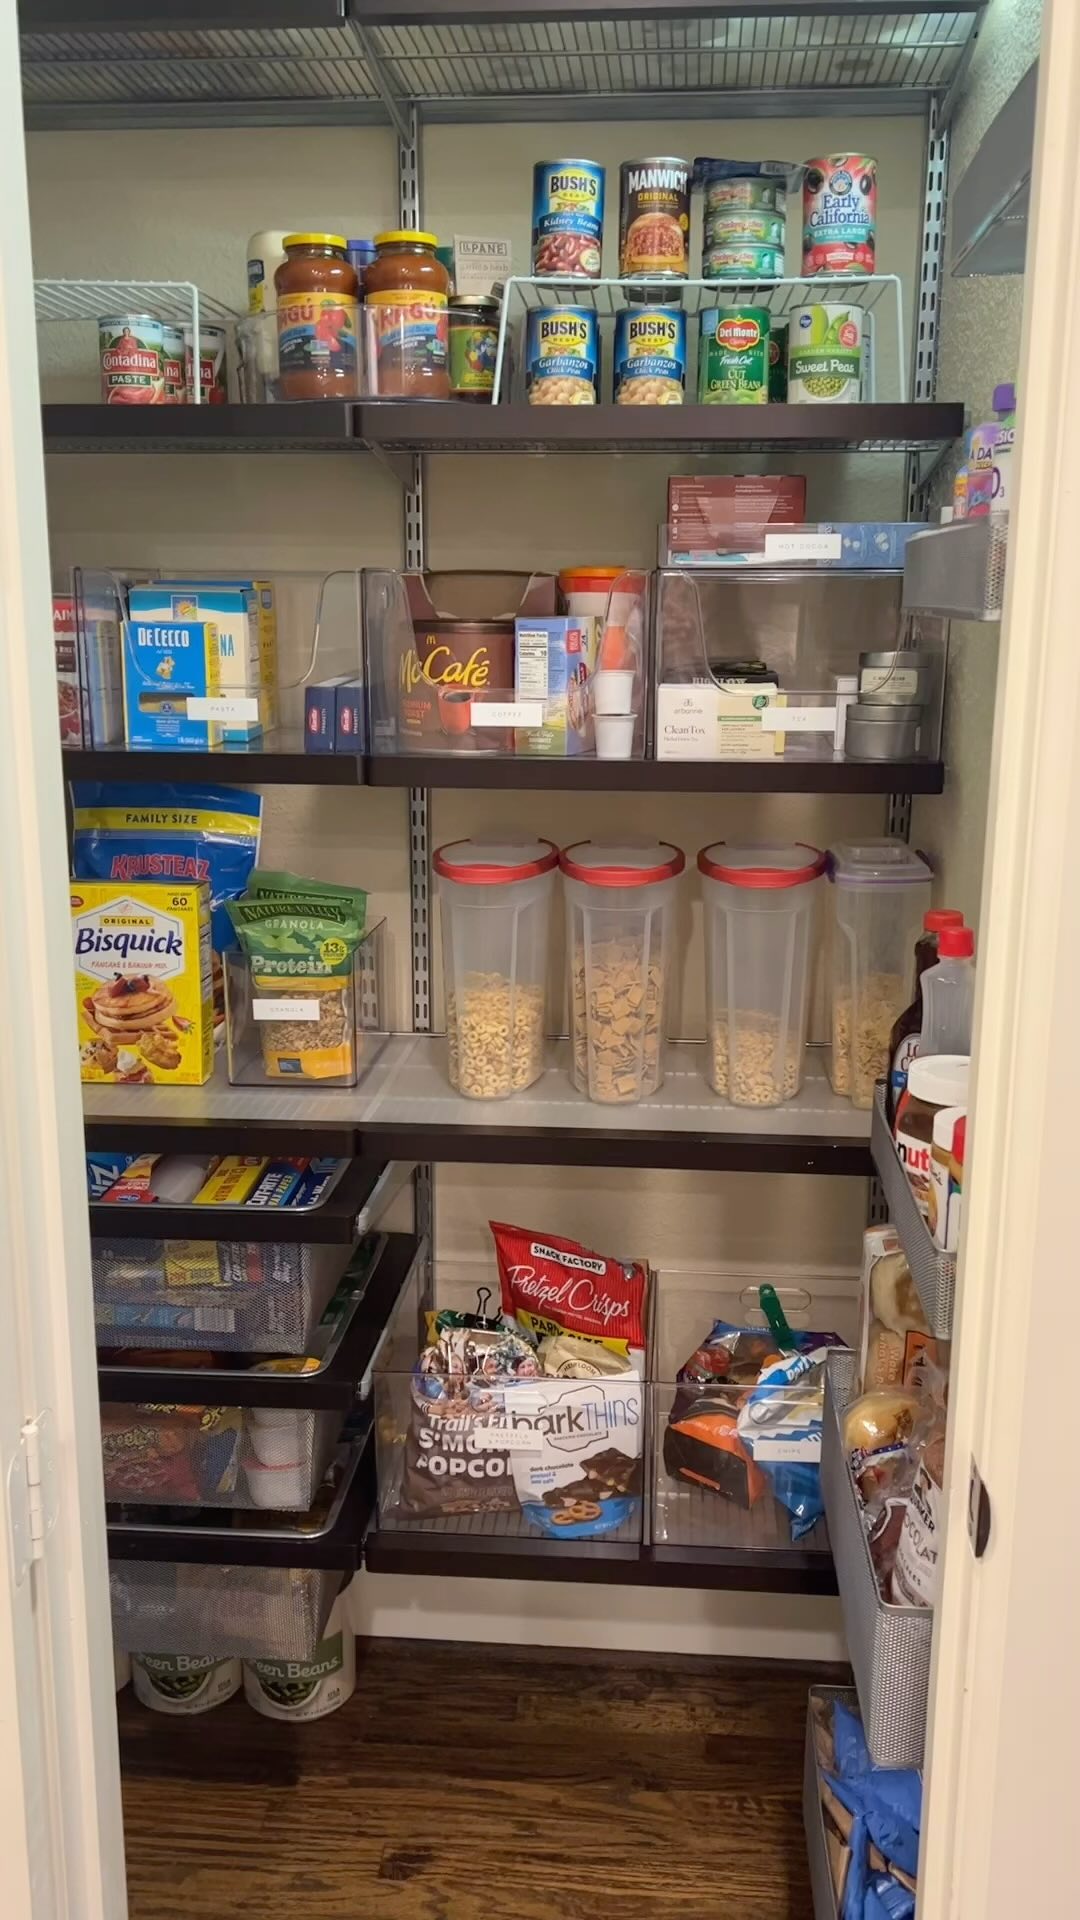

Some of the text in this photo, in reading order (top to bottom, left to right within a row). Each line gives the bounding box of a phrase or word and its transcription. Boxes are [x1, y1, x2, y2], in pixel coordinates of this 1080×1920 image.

[550, 175, 597, 197] BUSH'S
[627, 168, 688, 194] MANWICH
[637, 192, 679, 202] ORIGINAL
[822, 193, 860, 210] Early
[543, 215, 600, 230] Kidney Beans
[809, 208, 870, 228] California
[814, 228, 867, 238] EXTRA LARGE
[472, 243, 506, 255] PANE
[278, 298, 314, 325] AGÚ
[541, 321, 587, 339] BUSH'S
[629, 321, 676, 340] BUSH'S
[719, 327, 758, 338] Del Monte
[102, 353, 157, 371] Contadina
[538, 358, 589, 369] Garbanzos
[627, 358, 677, 369] Garbanzos
[719, 355, 753, 366] Fresh Cut
[795, 359, 855, 374] Sweet Peas
[546, 367, 581, 375] Chick Peas
[634, 367, 669, 376] Chick Peas
[727, 369, 746, 379] CUT
[111, 375, 146, 384] PASTE
[710, 378, 761, 390] GREEN BEANS
[137, 627, 190, 648] DE CECCO
[219, 633, 235, 657] NA
[400, 645, 491, 694] McCafé
[664, 724, 706, 735] CleanTox
[125, 813, 198, 825] FAMILY SIZE
[110, 853, 212, 881] KRUSTEAZ
[172, 897, 188, 907] 60
[243, 904, 341, 922] NATURE VALLEY
[264, 919, 324, 930] GRANOLA
[75, 927, 183, 959] Bisquick
[91, 961, 121, 969] PANCAKE
[250, 955, 333, 975] Protein
[533, 1244, 603, 1272] SNACK FACTORY
[507, 1264, 631, 1327] Pretzel Crisps
[428, 1413, 484, 1432] Trail's
[529, 1462, 574, 1473] dark chocolate
[145, 1654, 215, 1672] een Bea
[255, 1655, 342, 1679] een Beans
